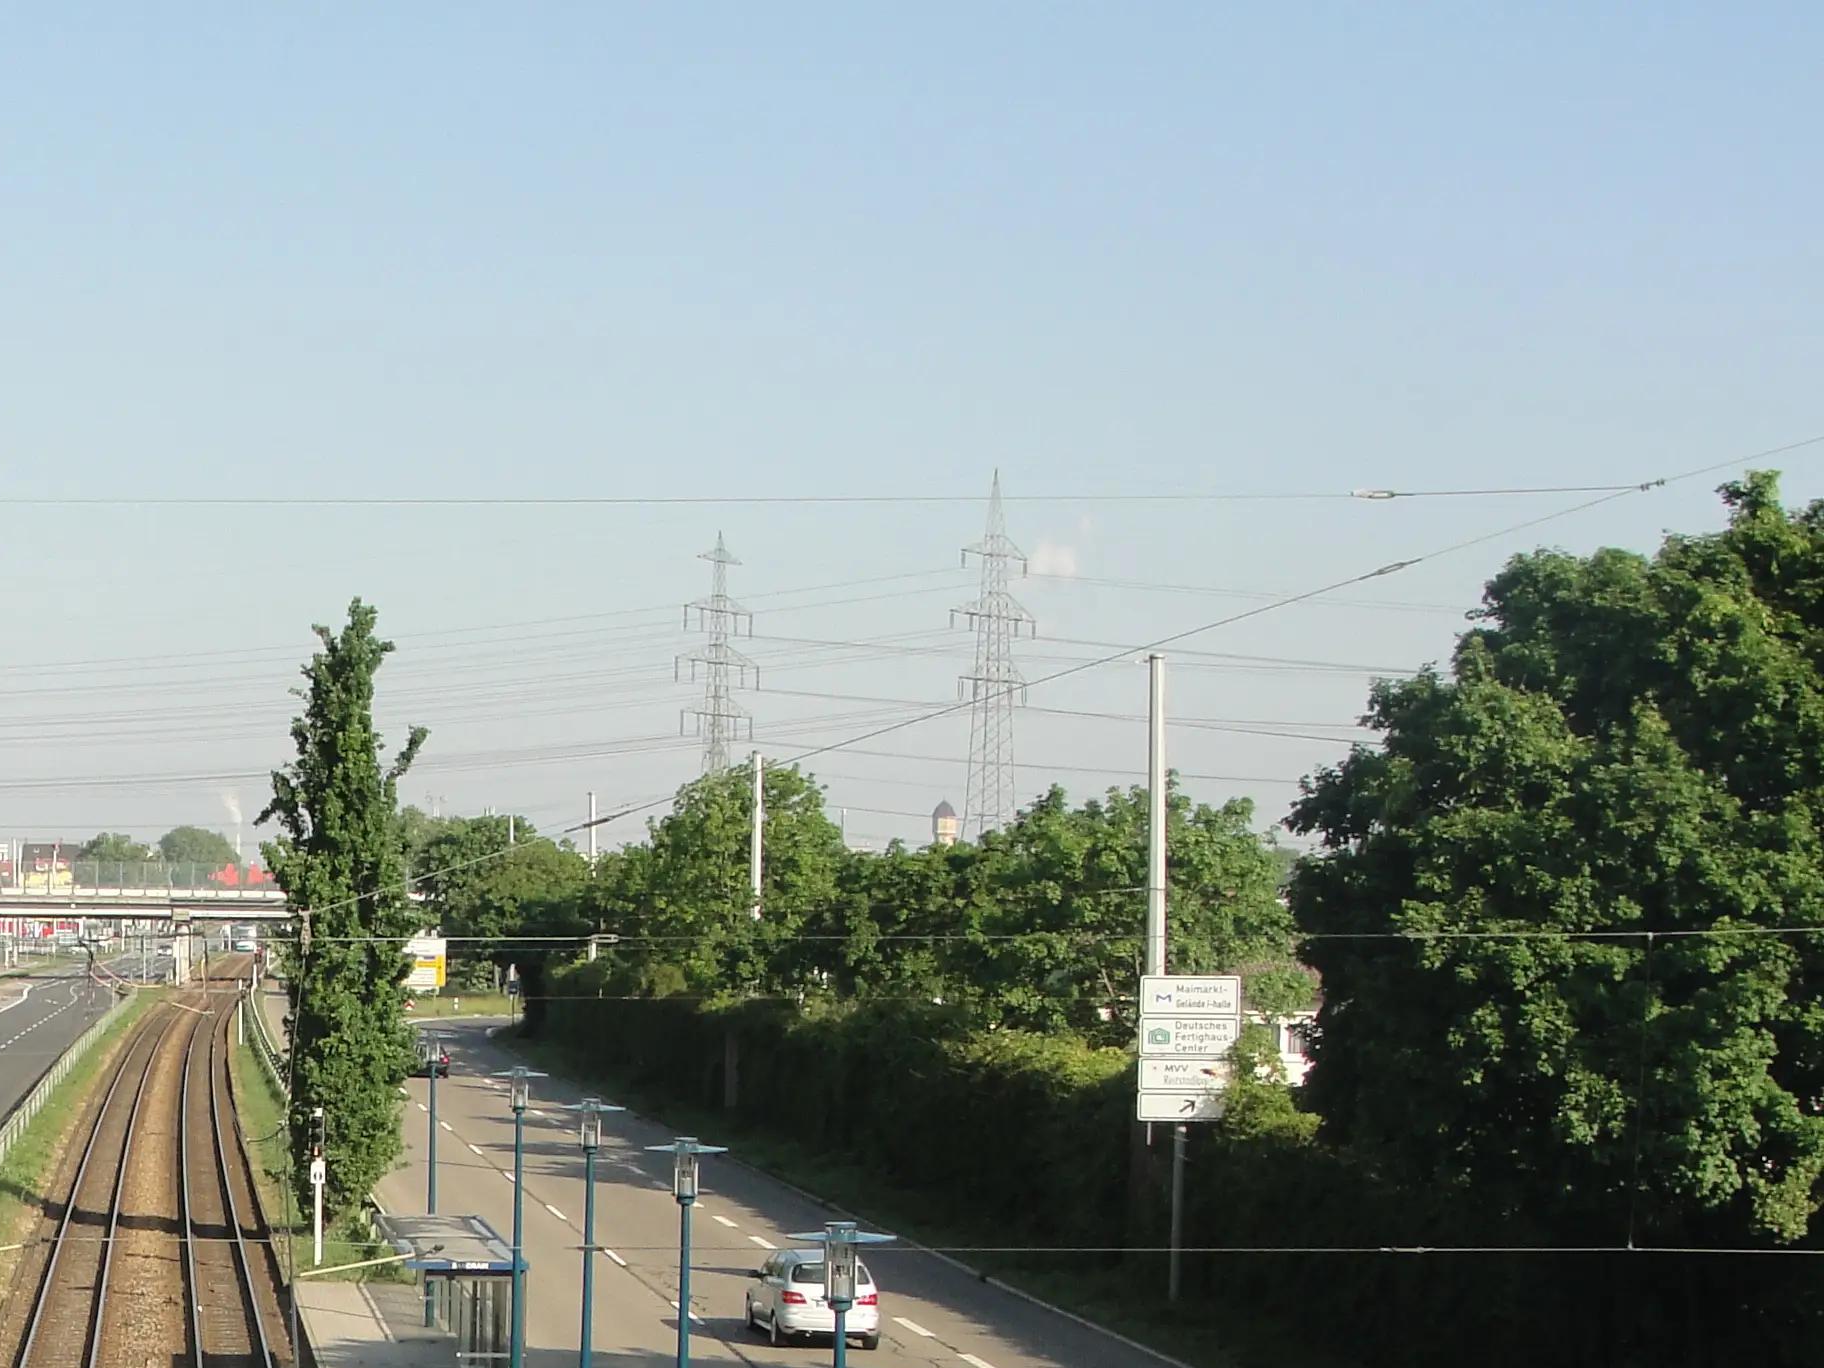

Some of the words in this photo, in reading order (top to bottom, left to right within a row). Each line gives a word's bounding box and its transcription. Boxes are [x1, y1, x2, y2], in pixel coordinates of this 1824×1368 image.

[1175, 1021, 1228, 1030] Deutsches
[1174, 1043, 1209, 1052] Center
[1164, 1064, 1189, 1073] MVV
